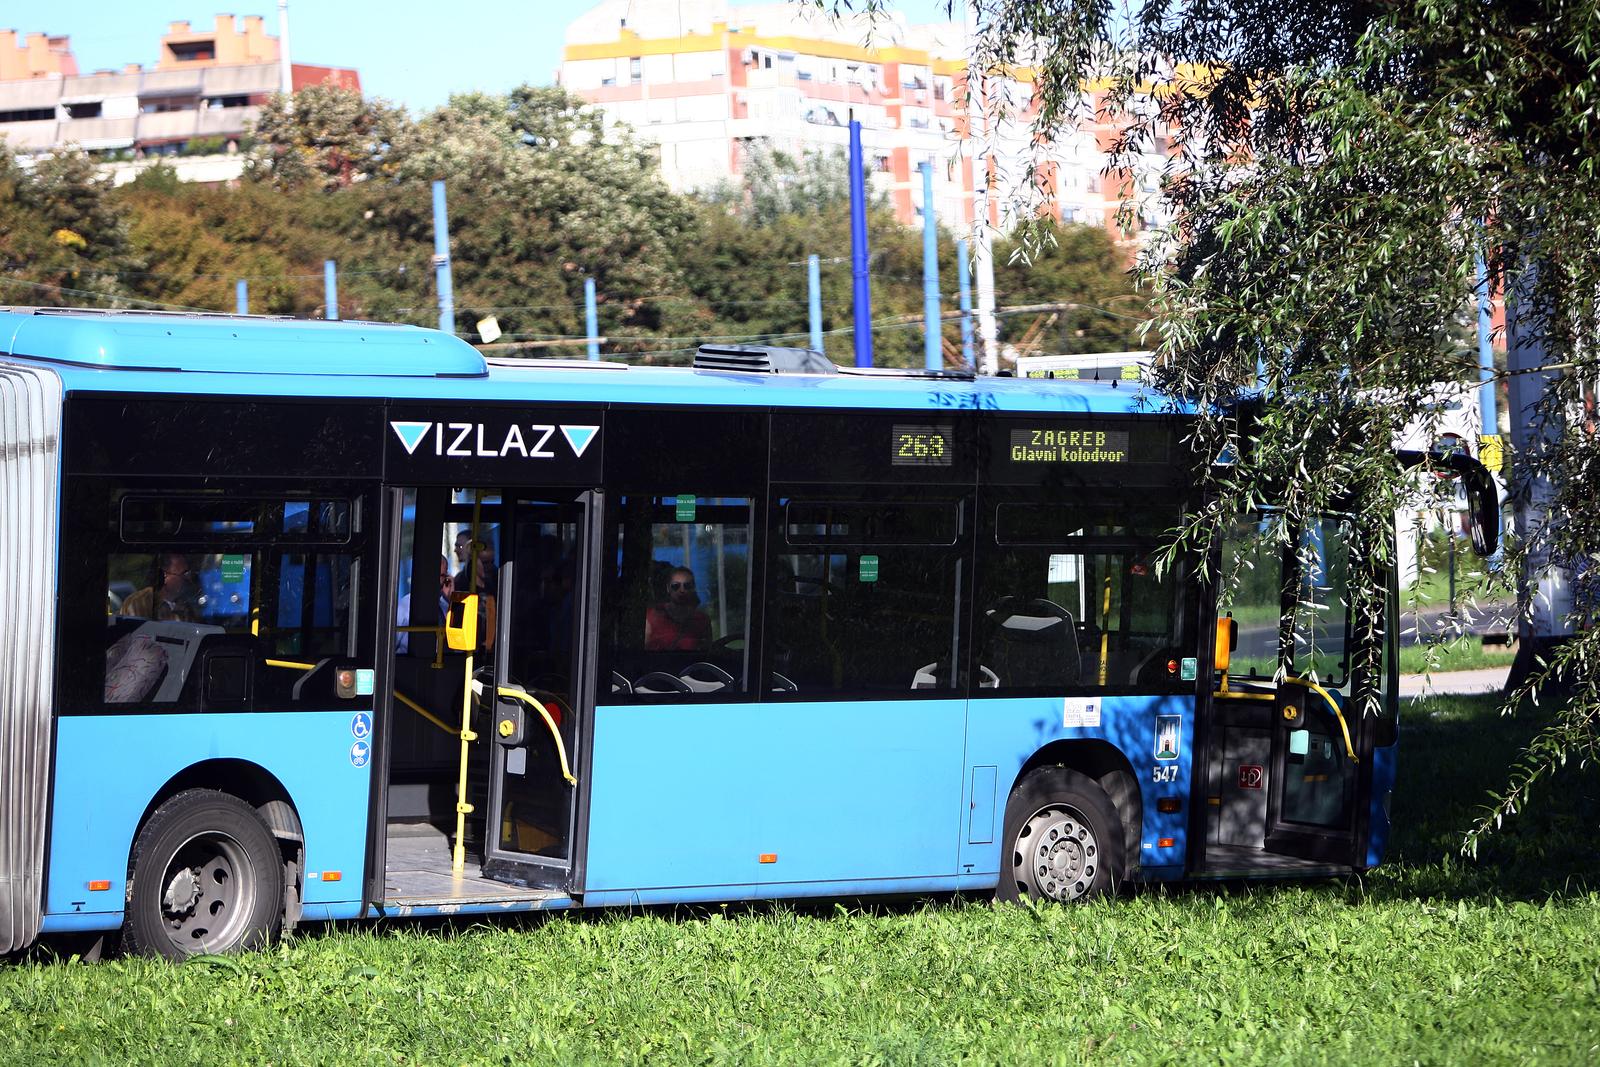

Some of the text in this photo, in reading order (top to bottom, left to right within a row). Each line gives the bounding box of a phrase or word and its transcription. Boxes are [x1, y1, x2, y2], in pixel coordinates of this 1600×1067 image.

[436, 422, 556, 458] IZLAZ
[898, 434, 944, 457] 268
[1031, 430, 1106, 446] ZAGREB
[1012, 445, 1125, 462] Glavni kolodvor
[1153, 765, 1179, 783] 547
